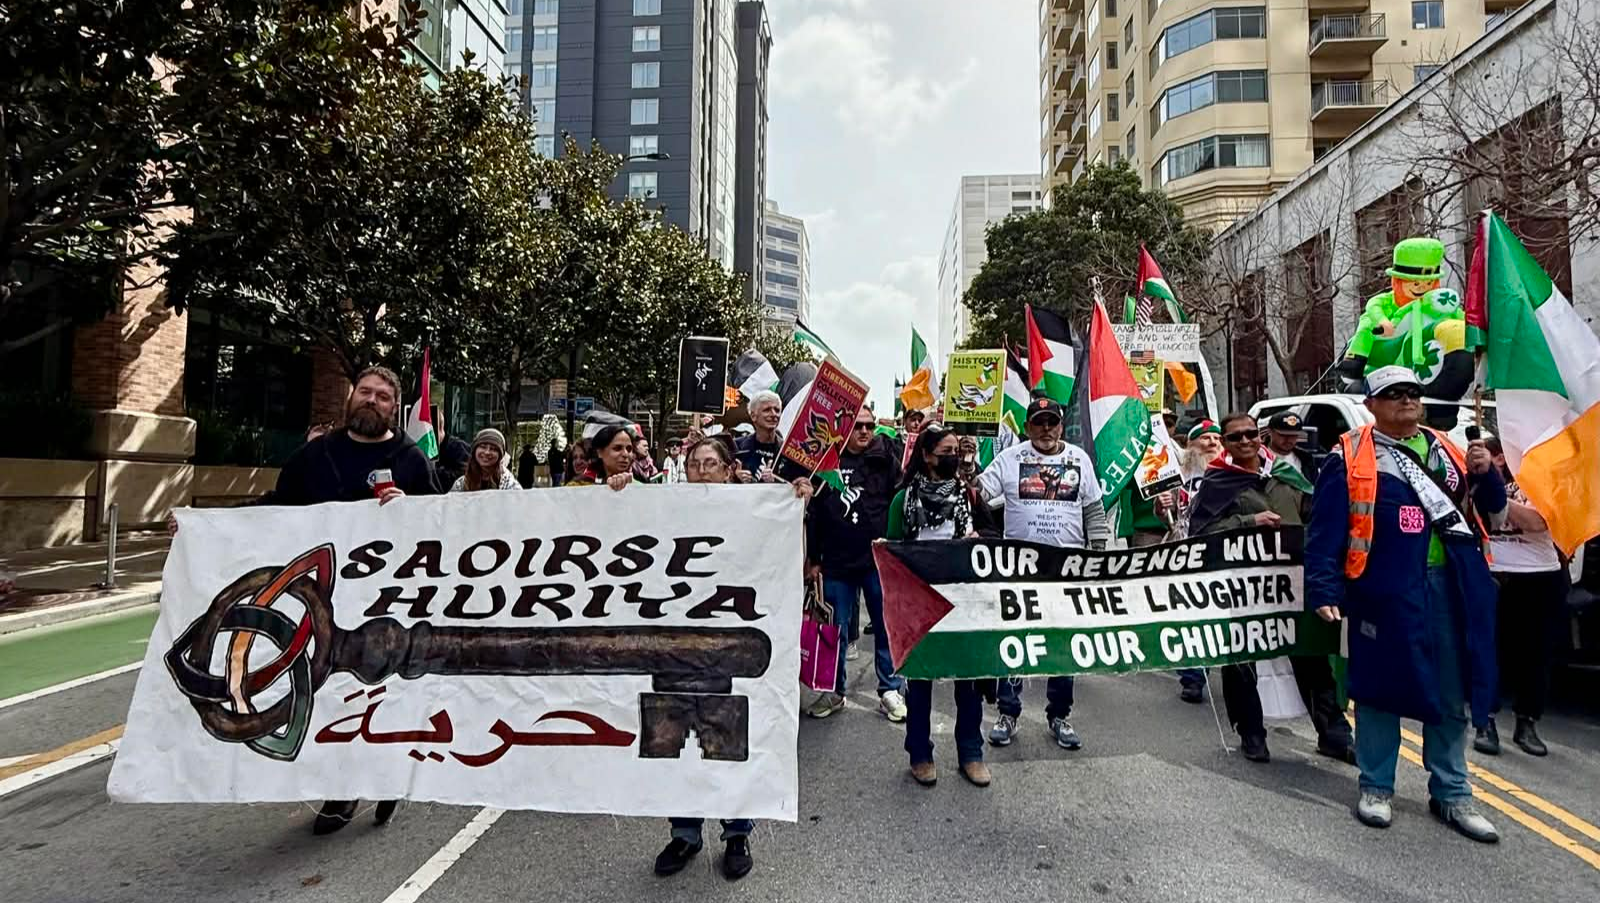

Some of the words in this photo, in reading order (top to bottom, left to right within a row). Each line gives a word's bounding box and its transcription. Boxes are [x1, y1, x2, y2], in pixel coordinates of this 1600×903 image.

[1138, 333, 1158, 342] AND
[1162, 334, 1176, 342] WE
[953, 356, 1000, 365] HISTORY
[812, 389, 833, 411] FREE
[823, 367, 863, 400] LIBERATION
[948, 410, 997, 418] RESISTANCE
[340, 534, 726, 580] SAOIRSE
[971, 544, 1040, 578] OUR
[1061, 542, 1207, 578] REVENGE
[1223, 532, 1291, 563] WILL
[363, 582, 768, 620] HURIYA
[1001, 588, 1042, 622] BE
[1064, 586, 1128, 616] THE
[1144, 574, 1295, 612] LAUGHTER
[999, 633, 1048, 670] OF
[1071, 629, 1146, 669] OUR
[1160, 618, 1296, 664] CHILDREN
[314, 685, 637, 767] حرية
